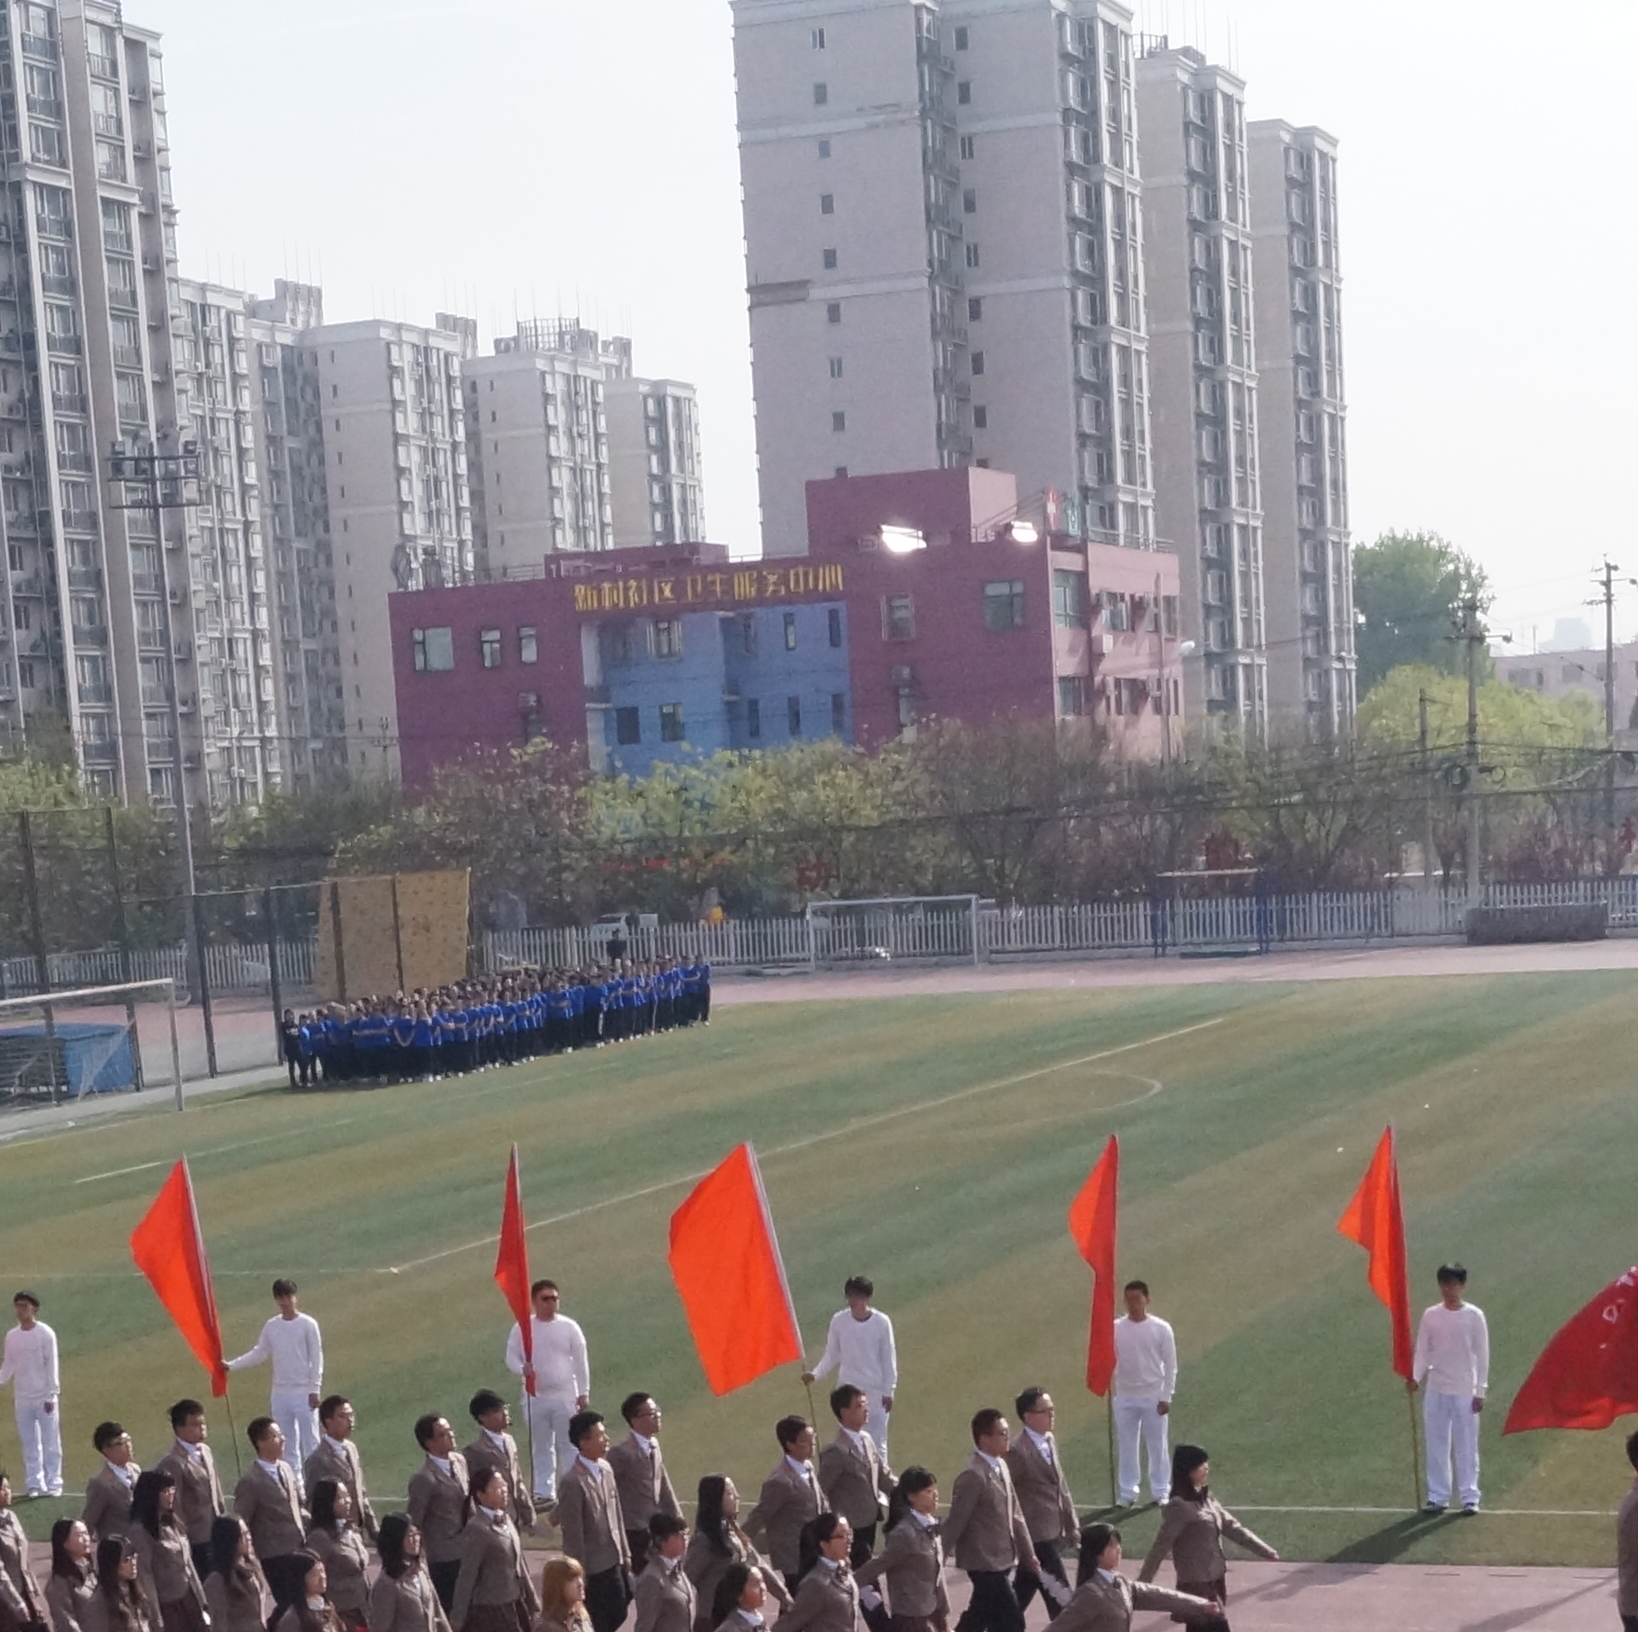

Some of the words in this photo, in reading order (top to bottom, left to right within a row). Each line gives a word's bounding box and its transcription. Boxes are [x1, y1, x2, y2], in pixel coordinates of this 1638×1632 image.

[573, 563, 844, 612] 新村社区卫生服务中心
